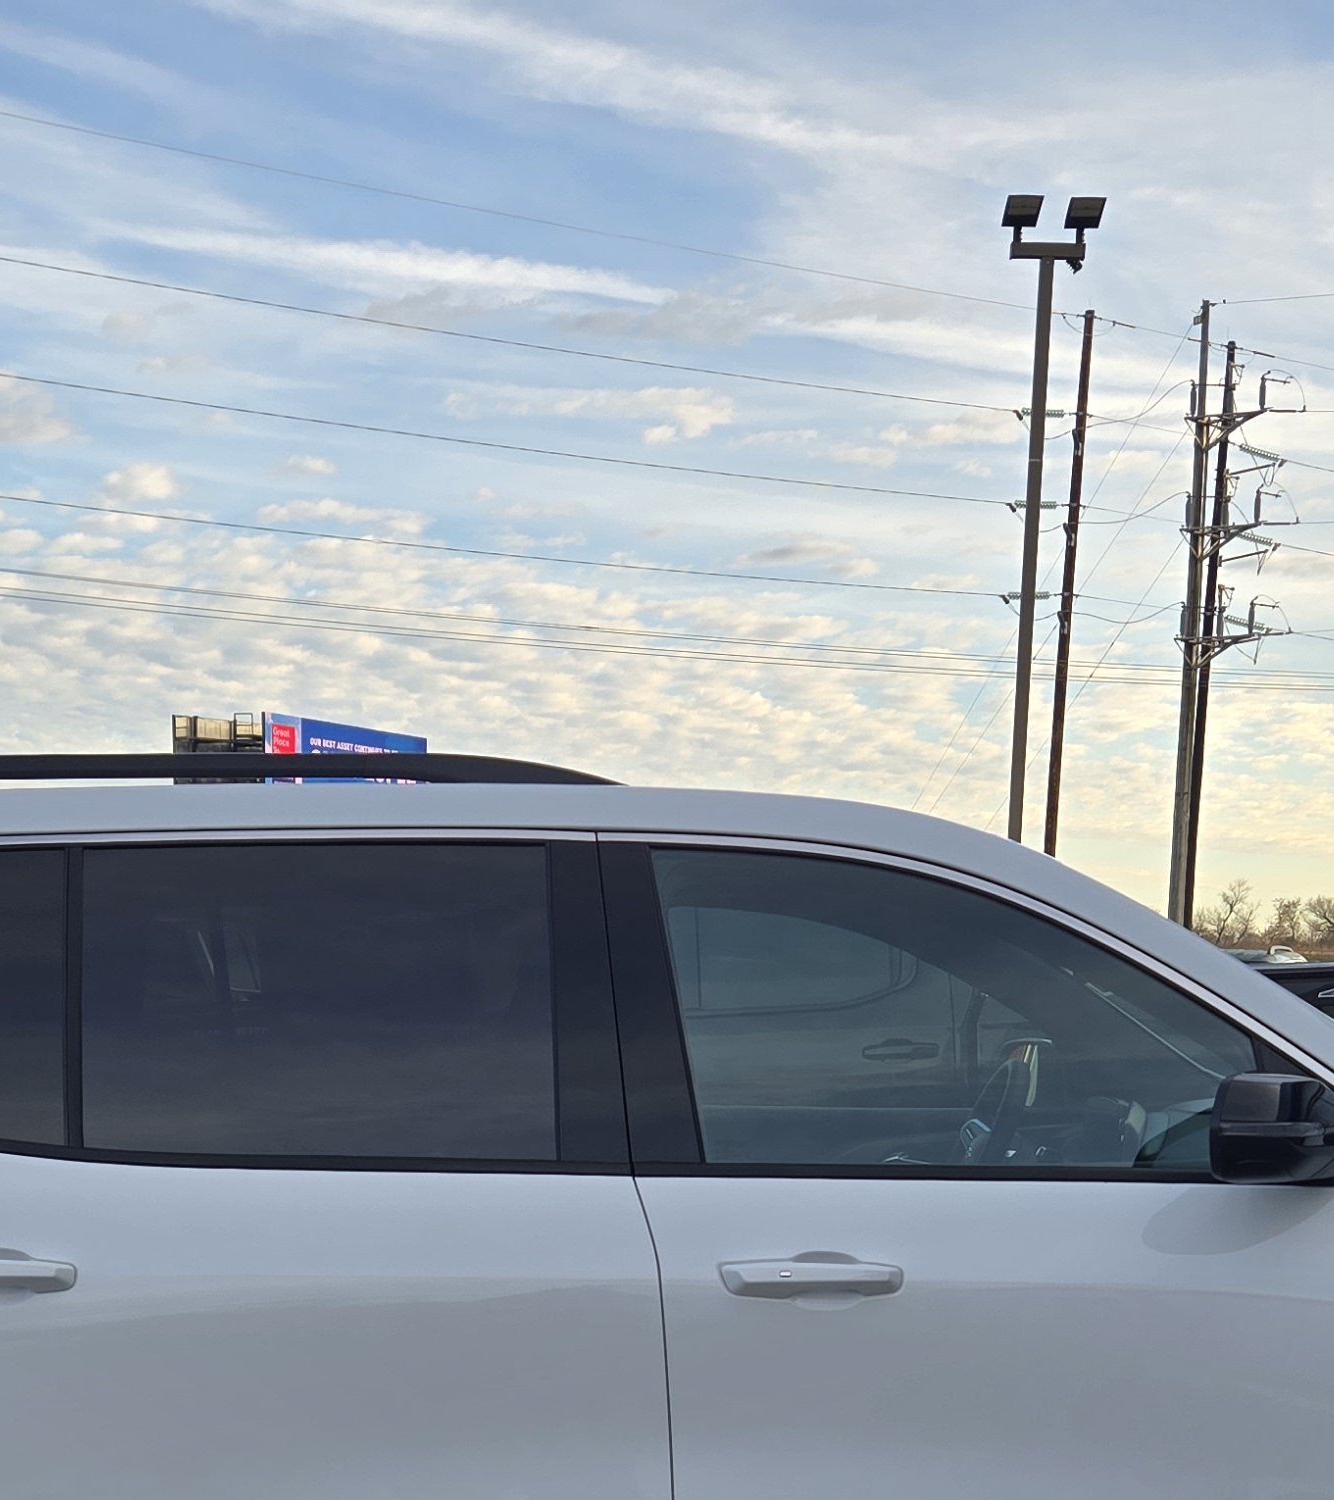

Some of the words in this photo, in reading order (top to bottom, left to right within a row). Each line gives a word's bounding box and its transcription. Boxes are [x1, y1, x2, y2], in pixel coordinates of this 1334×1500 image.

[272, 726, 290, 738] Great
[273, 736, 290, 748] Place
[309, 737, 322, 747] OUR
[322, 739, 336, 749] BEST
[336, 741, 354, 751] ASSET
